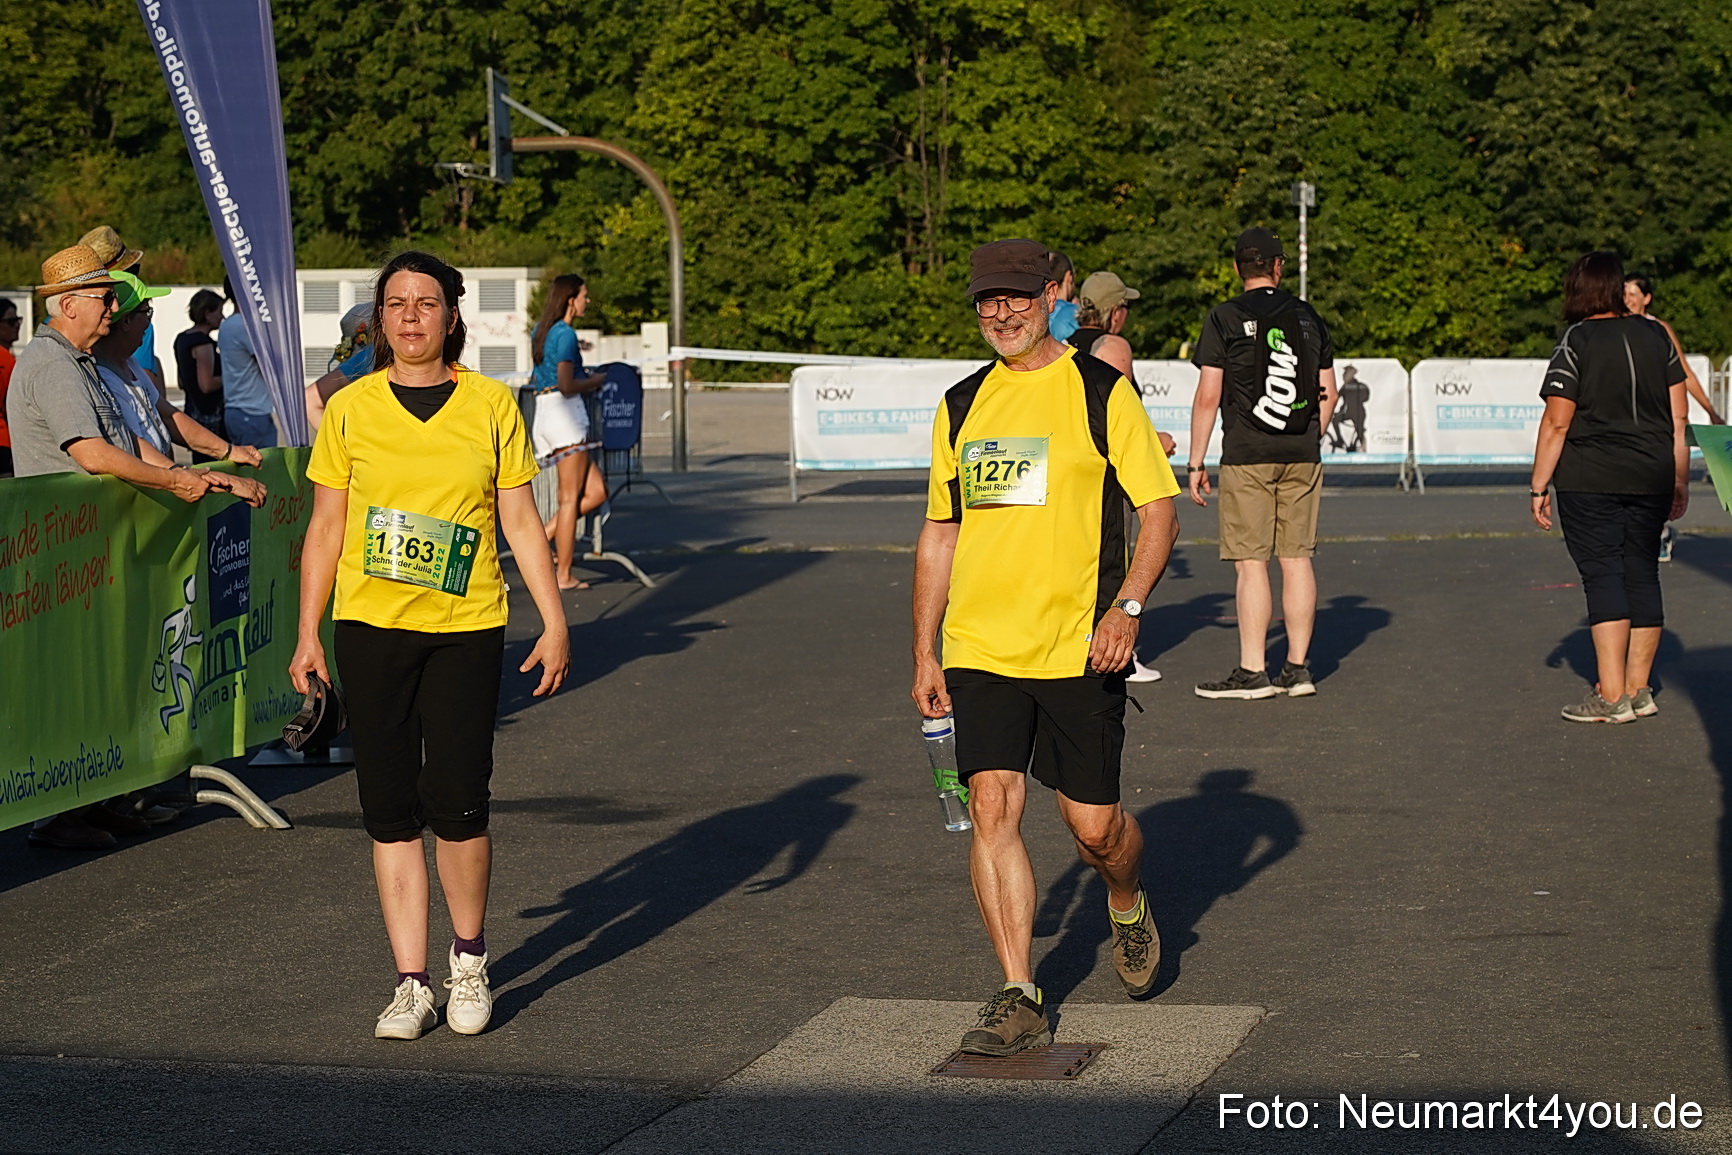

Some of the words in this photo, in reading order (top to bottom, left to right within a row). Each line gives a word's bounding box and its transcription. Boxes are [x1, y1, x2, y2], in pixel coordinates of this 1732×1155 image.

[816, 388, 854, 401] NOW
[1142, 383, 1171, 397] OW
[1252, 341, 1298, 431] now
[1435, 383, 1472, 396] NOW
[877, 411, 888, 423] &
[1496, 407, 1505, 418] &
[973, 460, 1031, 483] 1276
[974, 484, 992, 493] Theil
[45, 503, 98, 551] Firmen
[365, 533, 375, 566] WALK
[376, 531, 435, 563] 1263
[413, 562, 433, 575] Julia
[432, 547, 446, 579] 2022
[0, 570, 51, 631] laufen
[55, 536, 114, 611] länger!
